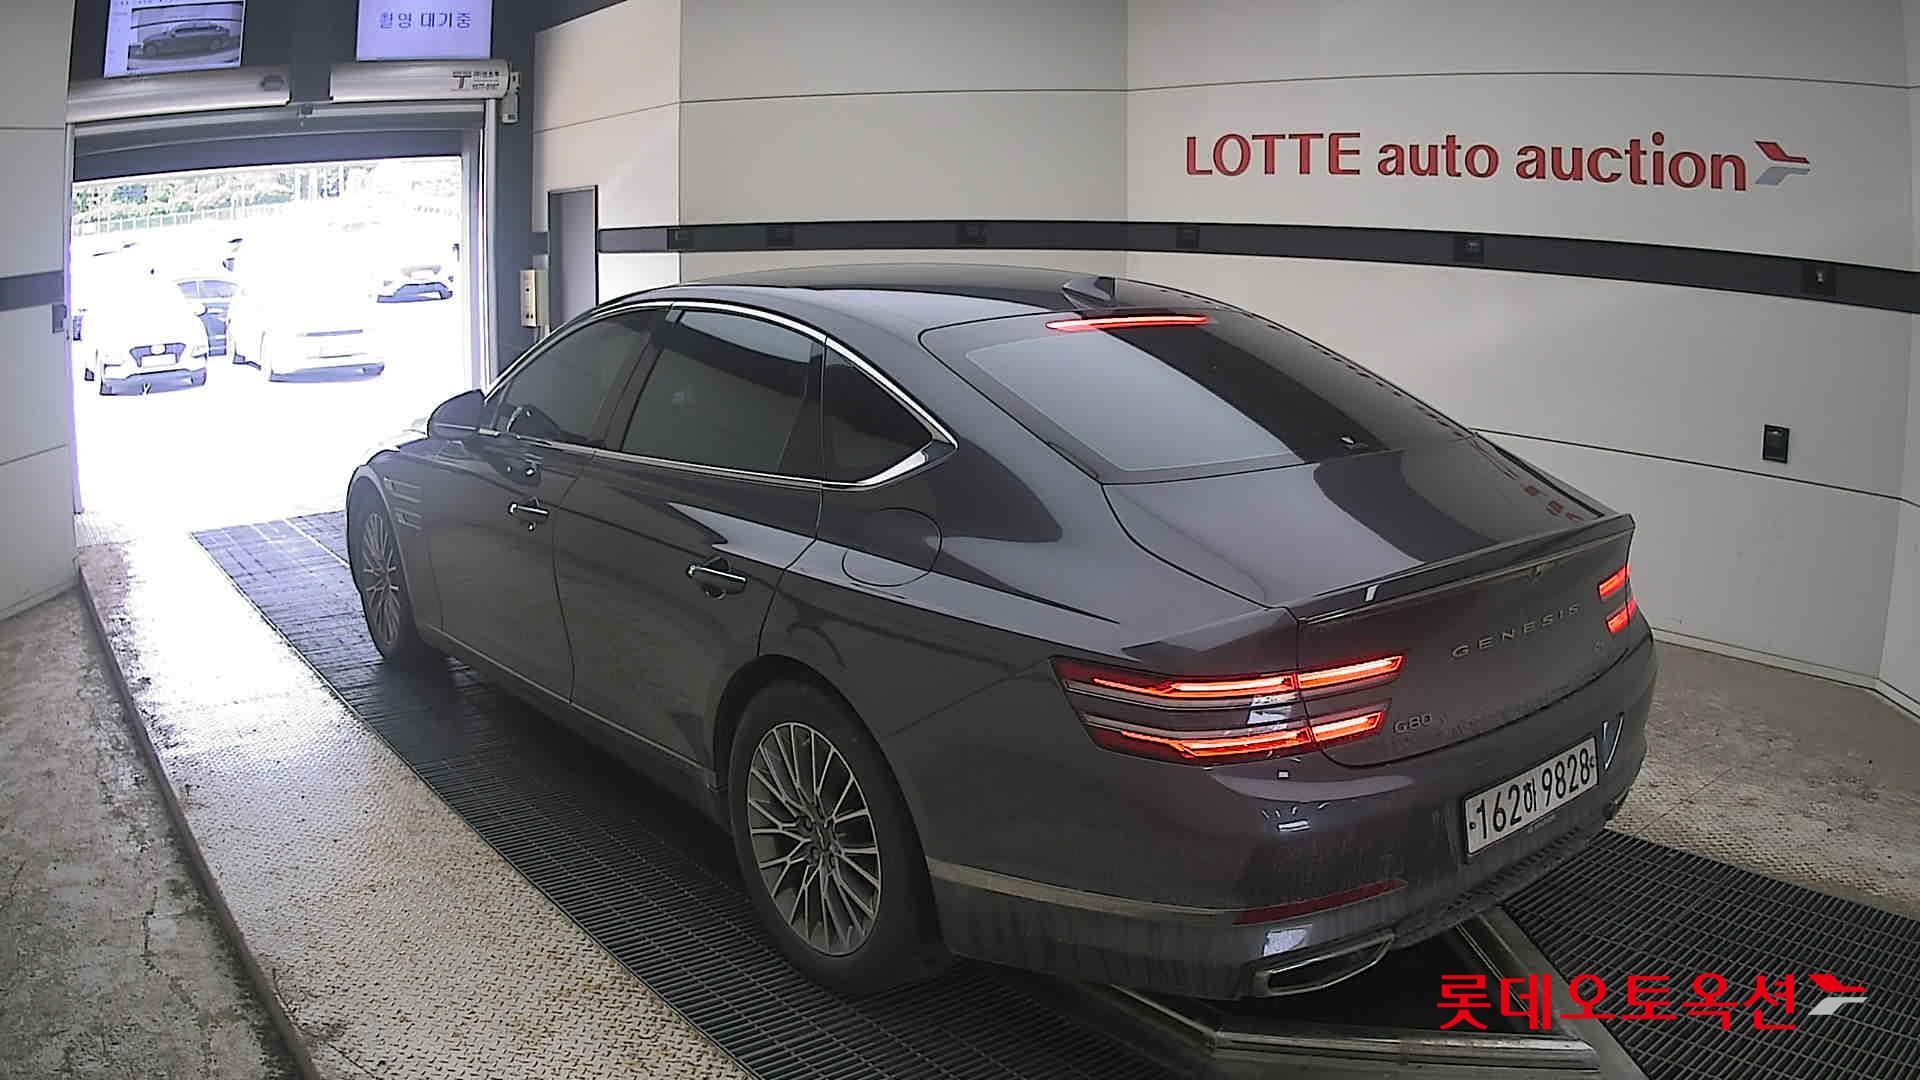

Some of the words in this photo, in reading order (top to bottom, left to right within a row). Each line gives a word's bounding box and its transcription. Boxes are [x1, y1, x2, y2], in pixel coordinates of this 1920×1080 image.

[420, 12, 472, 29] 대기중
[1186, 132, 1361, 176] LOTTE
[1377, 134, 1499, 178] auto
[1515, 131, 1747, 191] auction
[1451, 603, 1581, 658] GENESIS
[1393, 712, 1433, 734] G80
